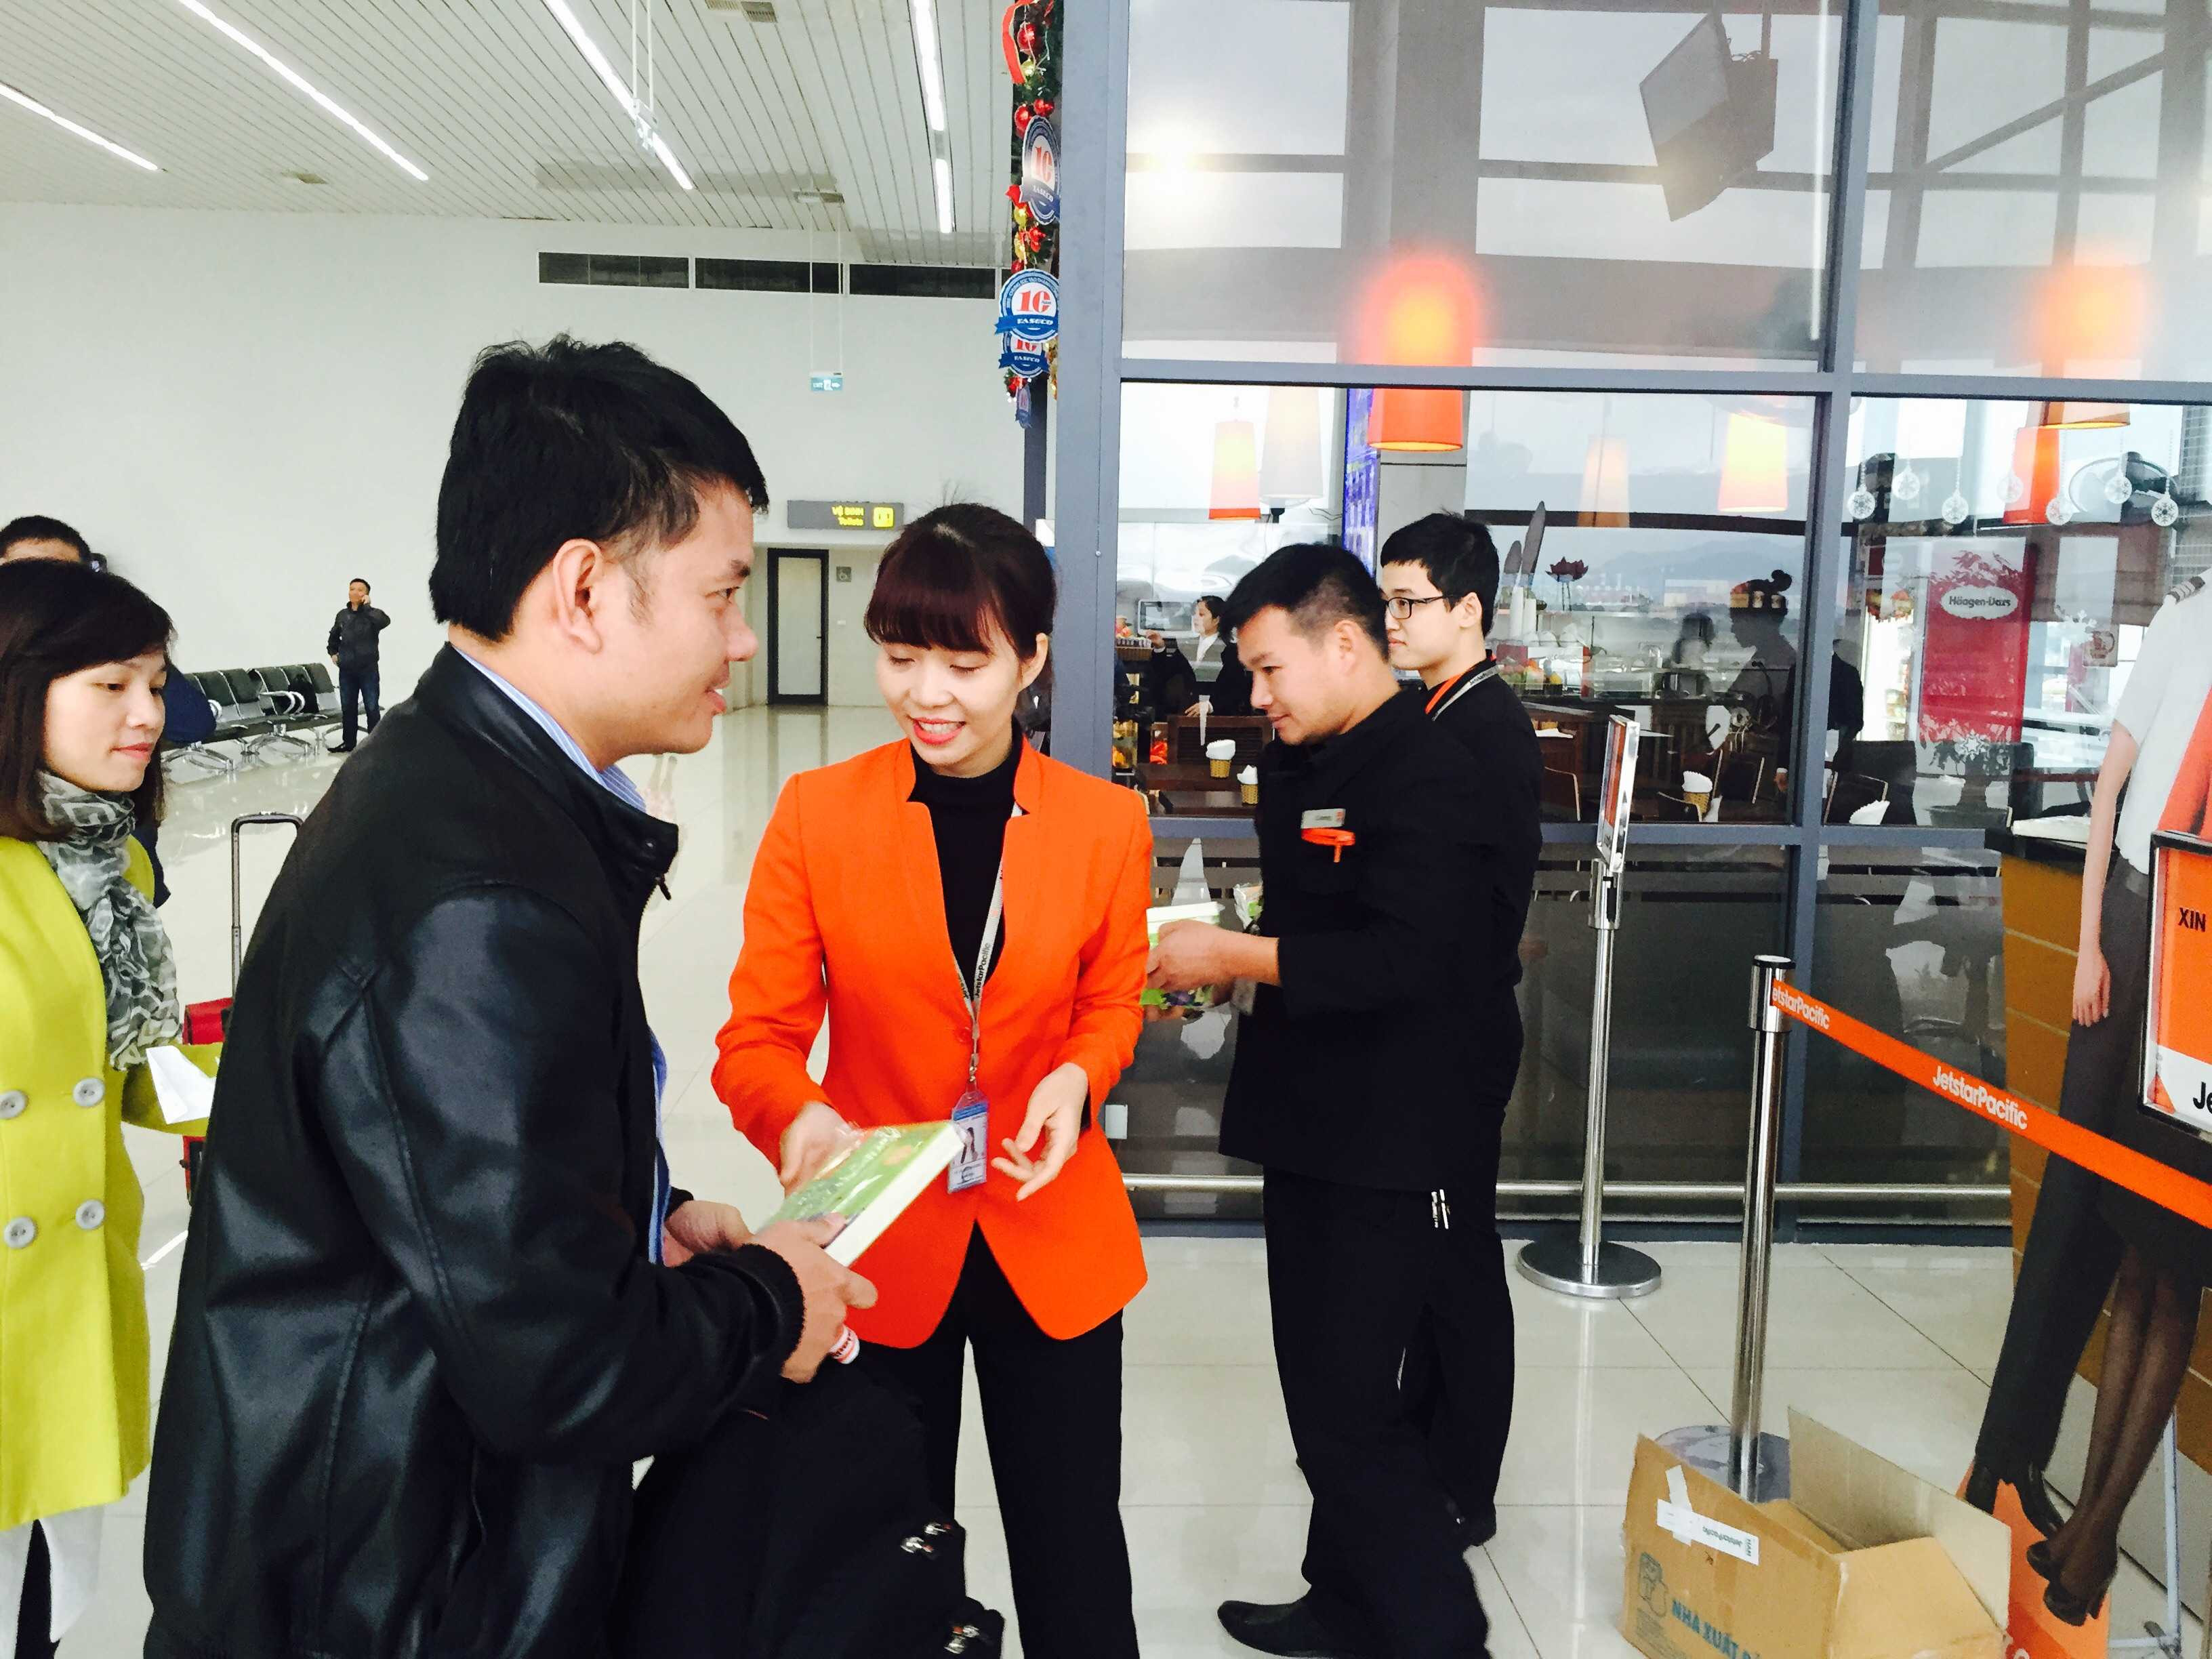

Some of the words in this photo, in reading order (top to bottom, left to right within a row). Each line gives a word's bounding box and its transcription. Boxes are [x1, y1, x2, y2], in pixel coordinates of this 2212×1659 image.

[1017, 290, 1051, 313] 10
[2177, 907, 2207, 933] XIN
[975, 943, 991, 999] JetstarPacific
[1772, 985, 1830, 1030] etstarPacific
[1933, 1065, 2028, 1130] JetstarPacific
